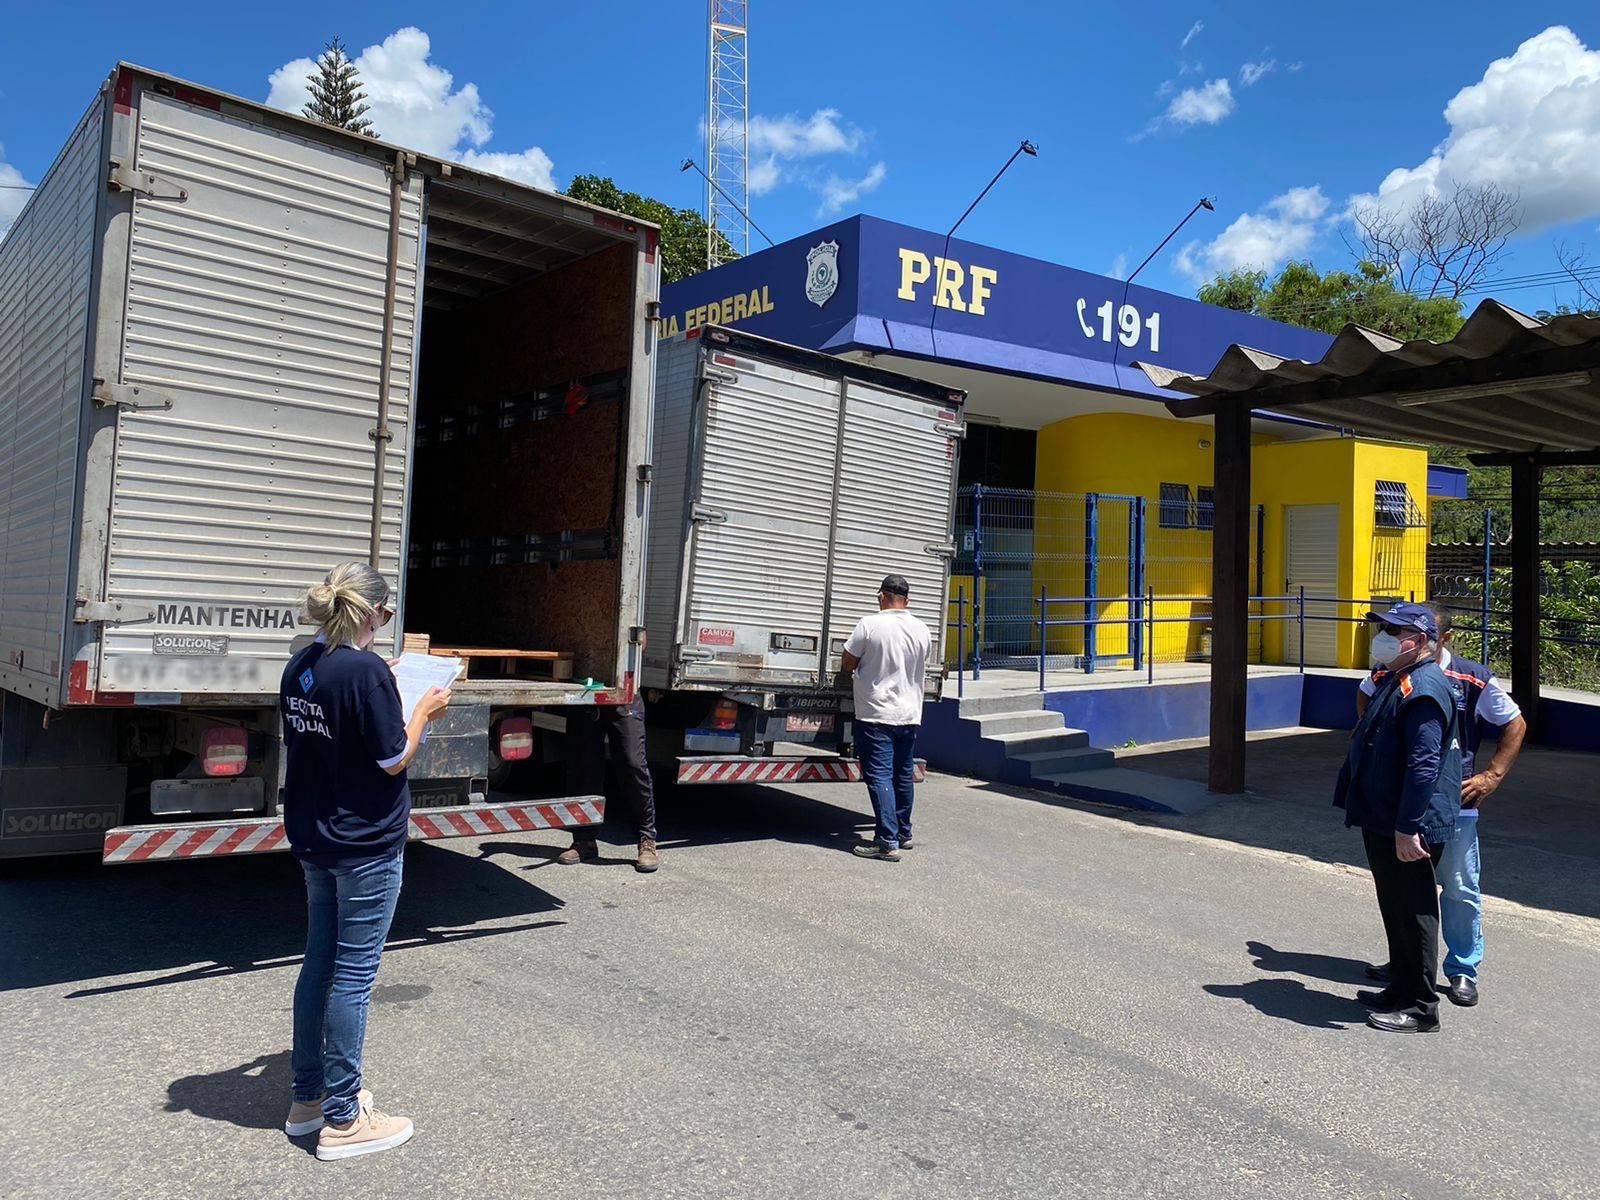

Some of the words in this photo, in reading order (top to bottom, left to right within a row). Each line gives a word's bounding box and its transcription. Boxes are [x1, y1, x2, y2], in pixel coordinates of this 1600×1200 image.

[898, 247, 998, 316] PRF
[685, 285, 774, 330] FEDERAL
[1097, 300, 1160, 352] 191
[157, 604, 296, 630] MANTENHA
[701, 628, 734, 638] CAMUZI
